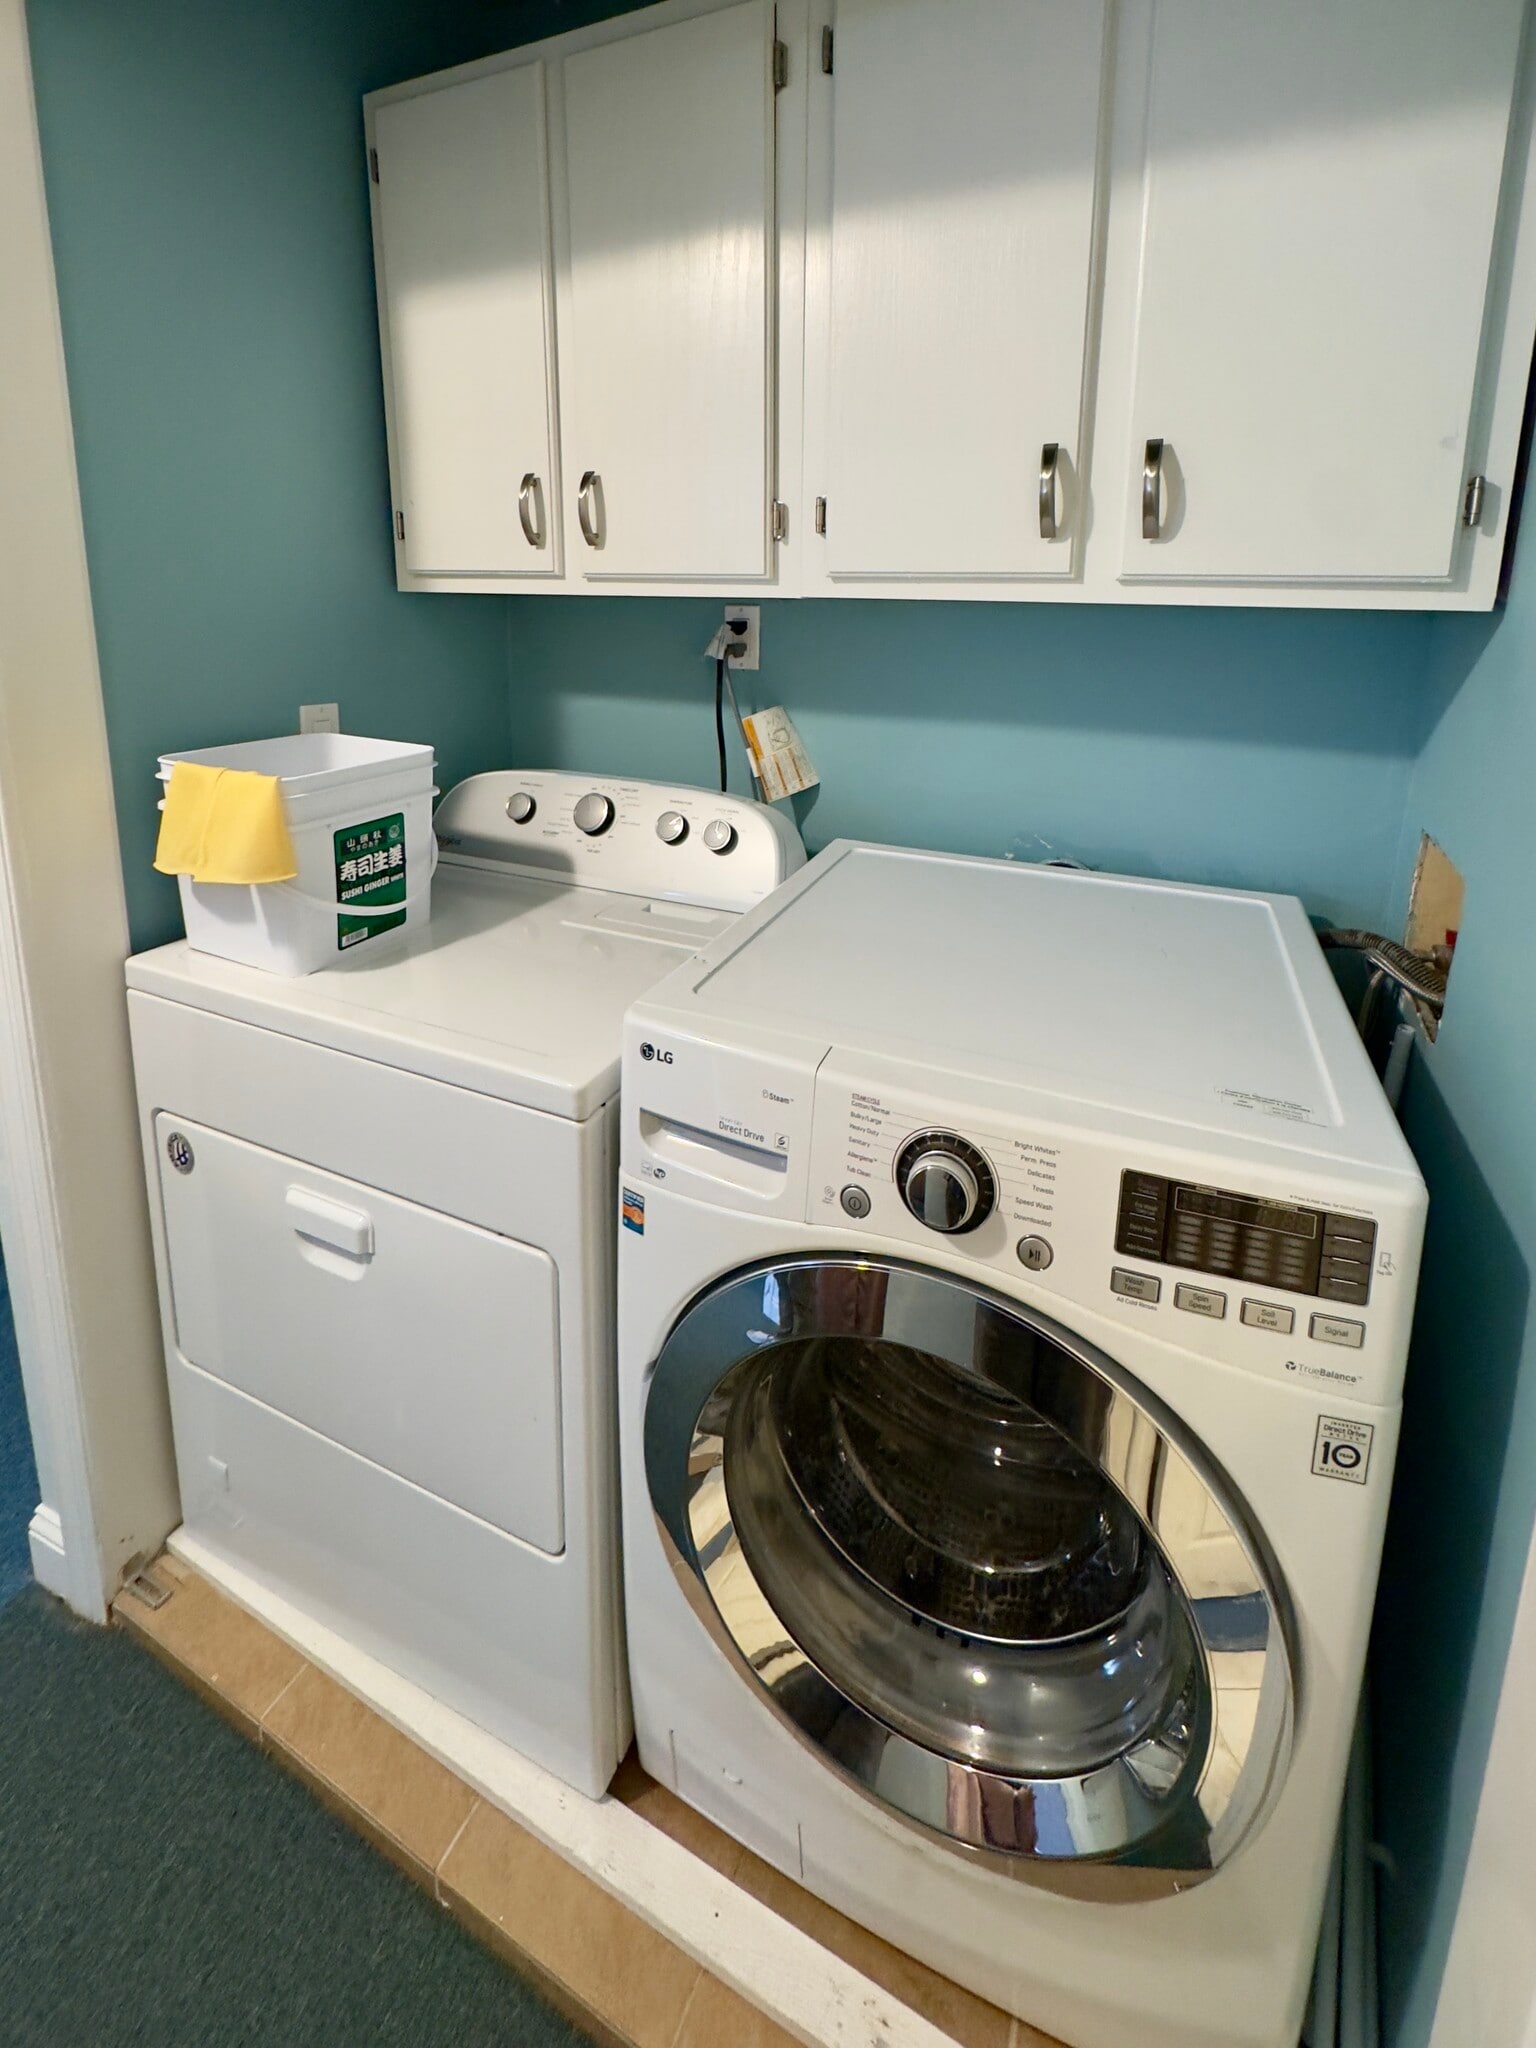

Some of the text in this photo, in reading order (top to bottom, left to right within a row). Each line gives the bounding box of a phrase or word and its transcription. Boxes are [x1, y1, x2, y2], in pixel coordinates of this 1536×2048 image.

[341, 885, 363, 901] SUSHI
[364, 876, 390, 892] GINGER
[657, 1048, 673, 1065] LG
[851, 1100, 890, 1115] Cotton/Normal
[850, 1111, 882, 1125] Bulky/Large
[719, 1120, 765, 1143] Direct Drive
[849, 1122, 880, 1137] Heavy Duty
[848, 1136, 871, 1148] Sanitary
[1014, 1140, 1033, 1151] Bright
[1039, 1158, 1057, 1168] Press
[846, 1165, 871, 1178] Tub Clean
[1027, 1168, 1056, 1181] Delicates
[1032, 1184, 1054, 1195] Towels
[1015, 1197, 1053, 1211] Speed Wash
[1013, 1212, 1052, 1228] Downloaded
[1124, 1276, 1145, 1287] Wash
[1123, 1283, 1143, 1294] Temp
[1125, 1298, 1138, 1306] Cold
[1192, 1292, 1209, 1303] Spin
[1188, 1299, 1212, 1312] Speed
[1261, 1308, 1275, 1319] Soil
[1257, 1316, 1278, 1327] Level
[1324, 1325, 1349, 1338] Signal
[1323, 1424, 1367, 1438] Direct Drive
[1322, 1441, 1361, 1469] 10
